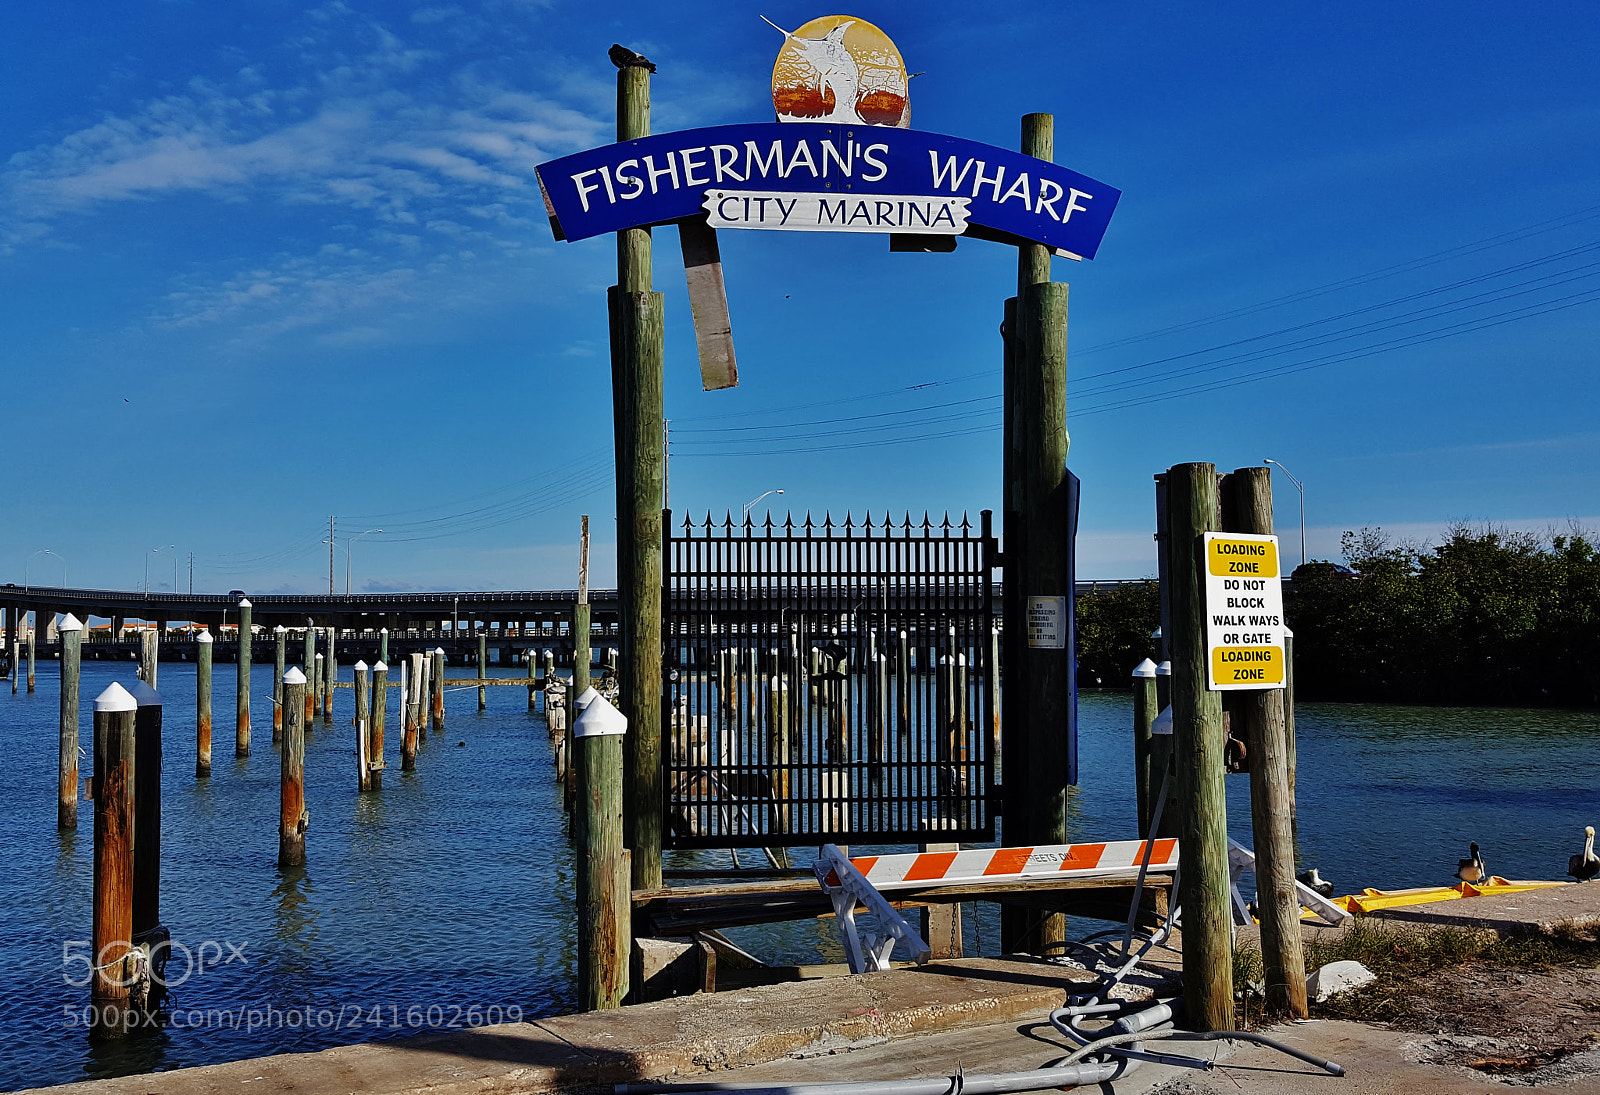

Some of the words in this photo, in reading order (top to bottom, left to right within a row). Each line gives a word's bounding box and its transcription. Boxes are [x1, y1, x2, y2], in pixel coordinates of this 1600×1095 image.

[570, 139, 889, 213] FISHERMAN'S
[929, 150, 1093, 224] WHARF
[717, 196, 797, 225] CITY
[817, 199, 956, 228] MARINA
[1217, 543, 1265, 556] LOADING
[1229, 562, 1259, 573] ZONE
[1224, 580, 1240, 590] DO
[1243, 580, 1265, 591] NOT
[1227, 597, 1264, 608] BLOCK
[1213, 615, 1246, 626] WALK
[1249, 615, 1279, 626] WAYS
[1223, 633, 1239, 644] OR
[1242, 633, 1271, 644] GATE
[1221, 651, 1271, 662] LOADING
[1233, 669, 1264, 680] ZONE
